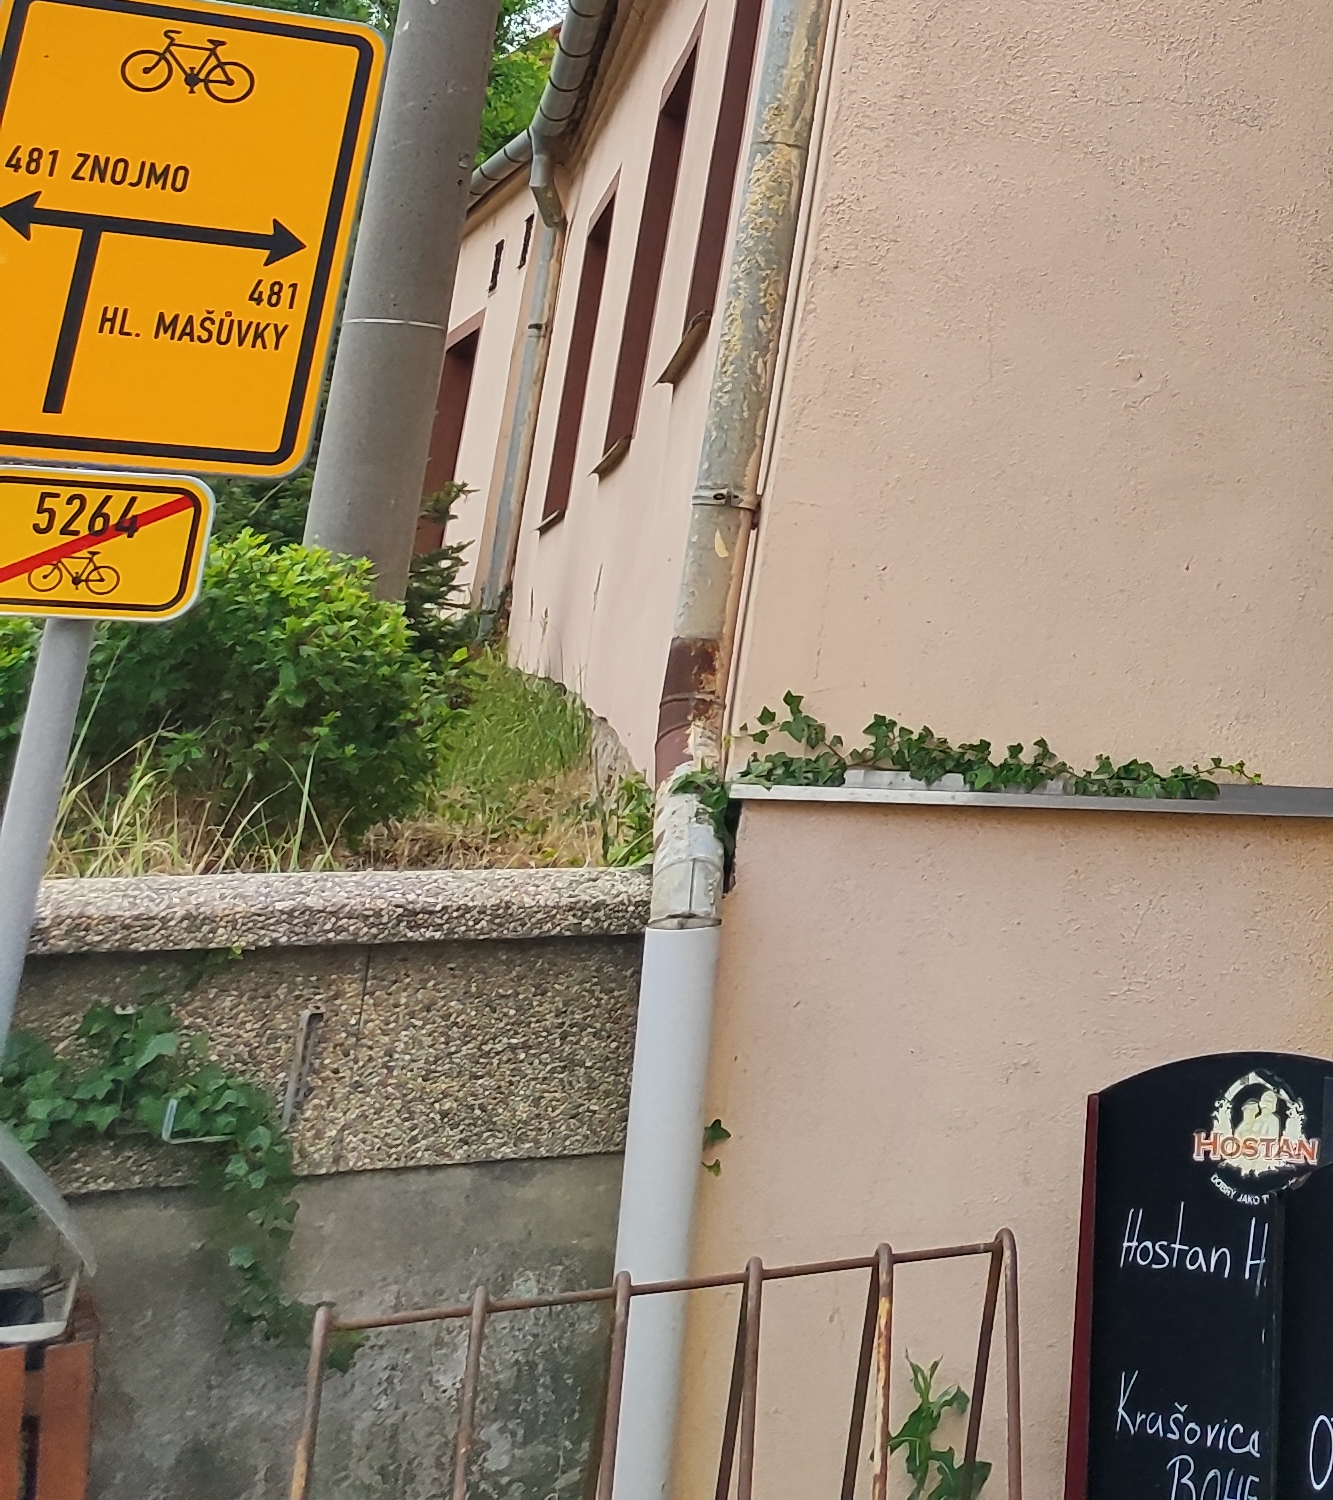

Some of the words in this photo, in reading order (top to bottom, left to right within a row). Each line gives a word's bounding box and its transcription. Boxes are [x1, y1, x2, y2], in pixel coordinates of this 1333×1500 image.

[4, 144, 59, 179] 481
[71, 151, 191, 194] ZNOJMO
[248, 280, 299, 310] 481
[98, 305, 141, 340] HL.
[154, 308, 289, 353] MAŠŮVKY
[32, 491, 141, 540] 5264
[1193, 1129, 1320, 1166] HOSTAN
[1237, 1192, 1260, 1205] JAKO
[1120, 1201, 1231, 1279] Hostan
